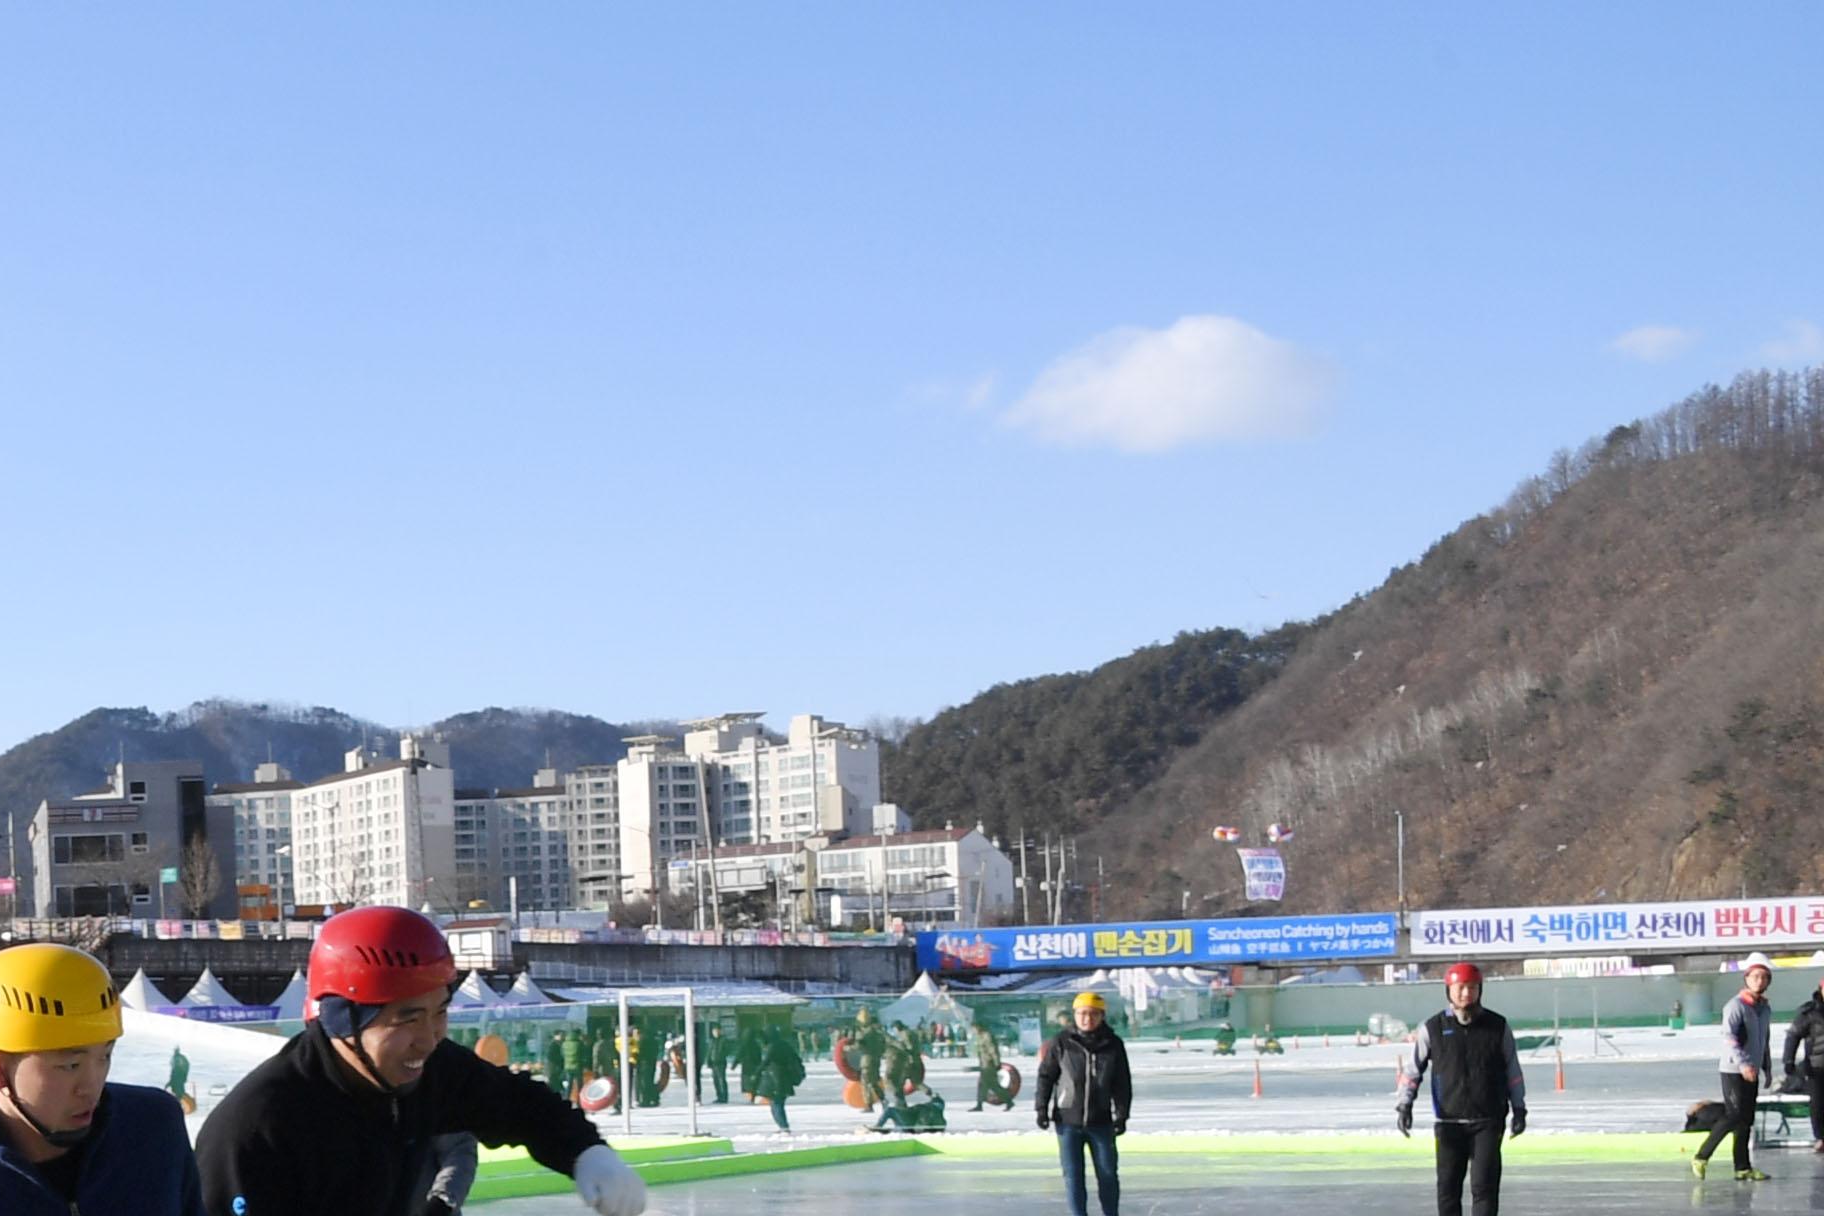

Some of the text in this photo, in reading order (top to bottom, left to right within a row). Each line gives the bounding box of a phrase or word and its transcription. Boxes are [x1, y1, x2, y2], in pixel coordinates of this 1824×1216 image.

[1282, 923, 1334, 939] Catching
[1336, 923, 1351, 938] by
[1351, 920, 1389, 935] hands
[1424, 918, 1514, 945] 화천에서
[1635, 912, 1706, 940] 산천어
[1714, 905, 1797, 938] 밤낚시
[1012, 932, 1087, 960] 산천어
[1093, 928, 1193, 958] 맨손잡기
